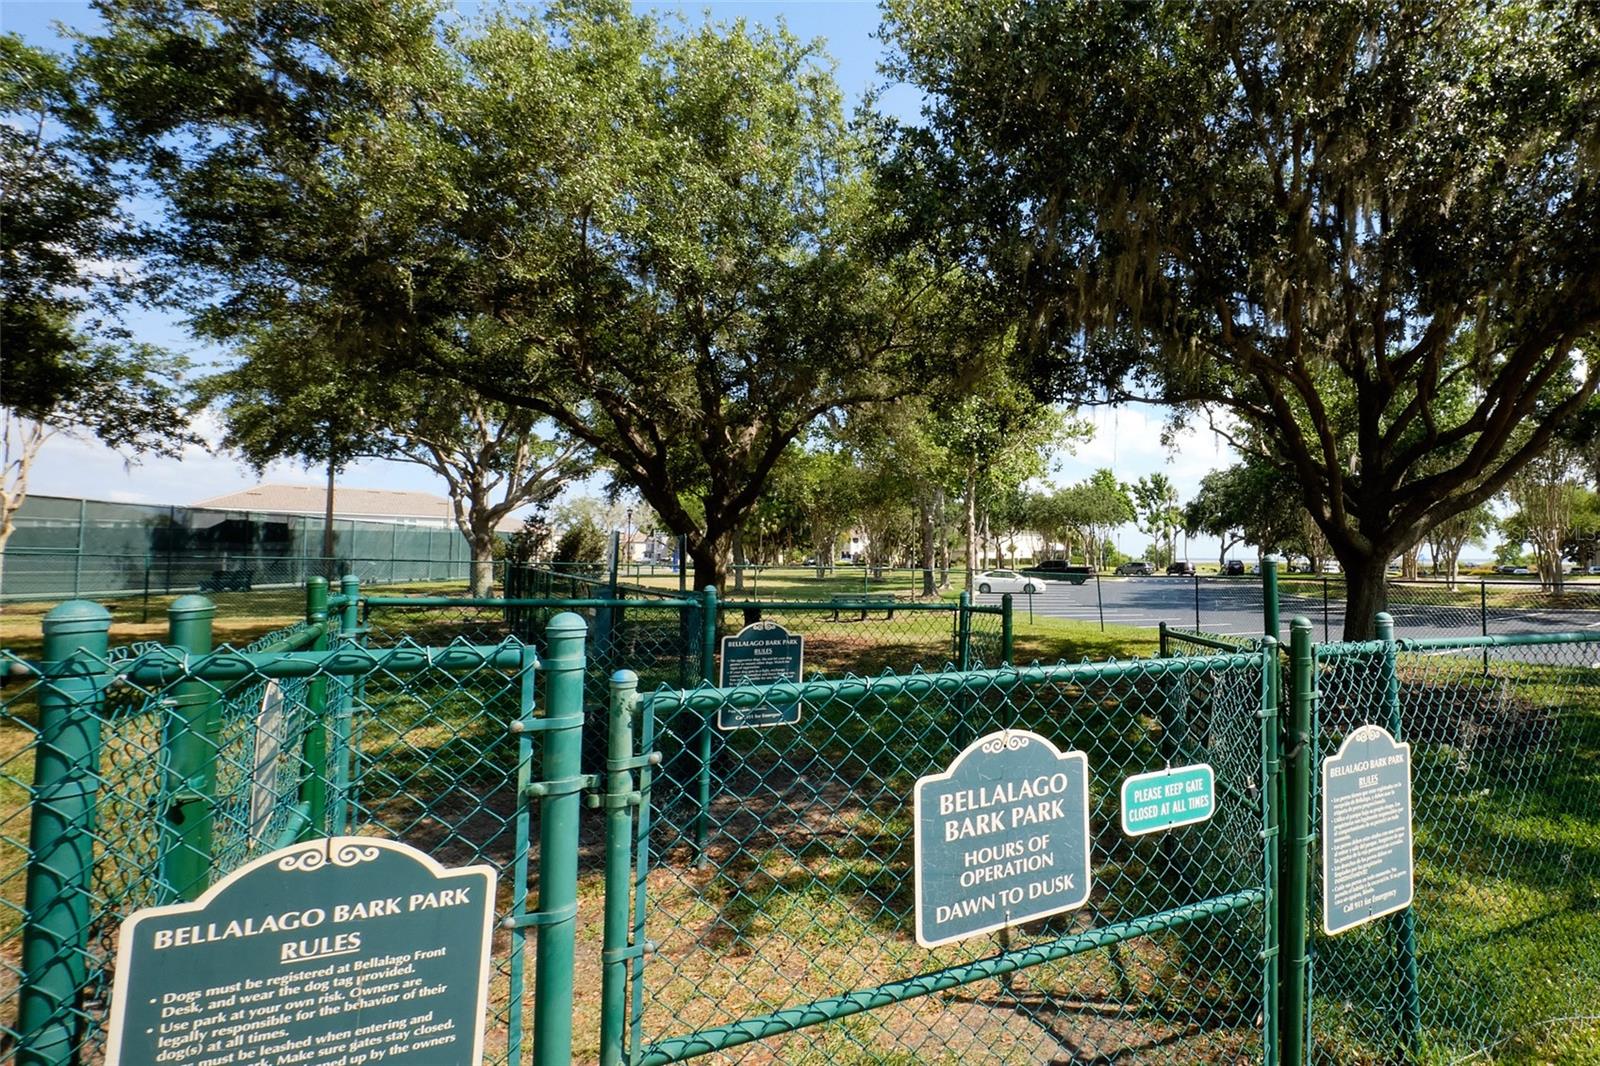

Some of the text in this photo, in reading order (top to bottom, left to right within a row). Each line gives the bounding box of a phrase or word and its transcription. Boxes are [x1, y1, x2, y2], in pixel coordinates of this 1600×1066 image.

[728, 640, 764, 648] BELLALAGO
[1330, 754, 1405, 778] BELLALAGO BARK PARK
[1359, 774, 1379, 788] RULES
[939, 773, 1068, 816] BELLALAGO
[1129, 794, 1209, 823] CLOSED AT ALL TIMES
[1134, 778, 1204, 803] PLEASE KEEP GATE
[945, 798, 1066, 842] BARK PARK
[964, 834, 1050, 868] HOURS OF
[959, 852, 1054, 888] OPERATION
[936, 873, 1074, 924] DAWN TO DUSK
[1343, 903, 1354, 913] Call
[153, 887, 472, 950] BELLALAGO BARK PARK
[280, 932, 362, 961] RULES
[161, 964, 416, 1018] Desk, and wear the dog tag provided.
[162, 947, 447, 1004] Dogs must be registered at Bellalago Front
[158, 984, 448, 1049] legally responsible for the behavior of their
[159, 978, 422, 1034] Use park at your own risk. Owners are
[156, 1030, 290, 1062] dog(s) at all times.
[198, 1011, 433, 1066] must be leashed when entering and
[276, 1050, 315, 1066] Make
[318, 1042, 348, 1057] sure
[349, 1035, 383, 1052] gates
[385, 1030, 411, 1046] stay
[413, 1019, 456, 1036] closed.
[350, 1054, 366, 1065] up
[370, 1047, 386, 1061] by
[389, 1044, 410, 1056] the
[412, 1034, 456, 1051] owners
